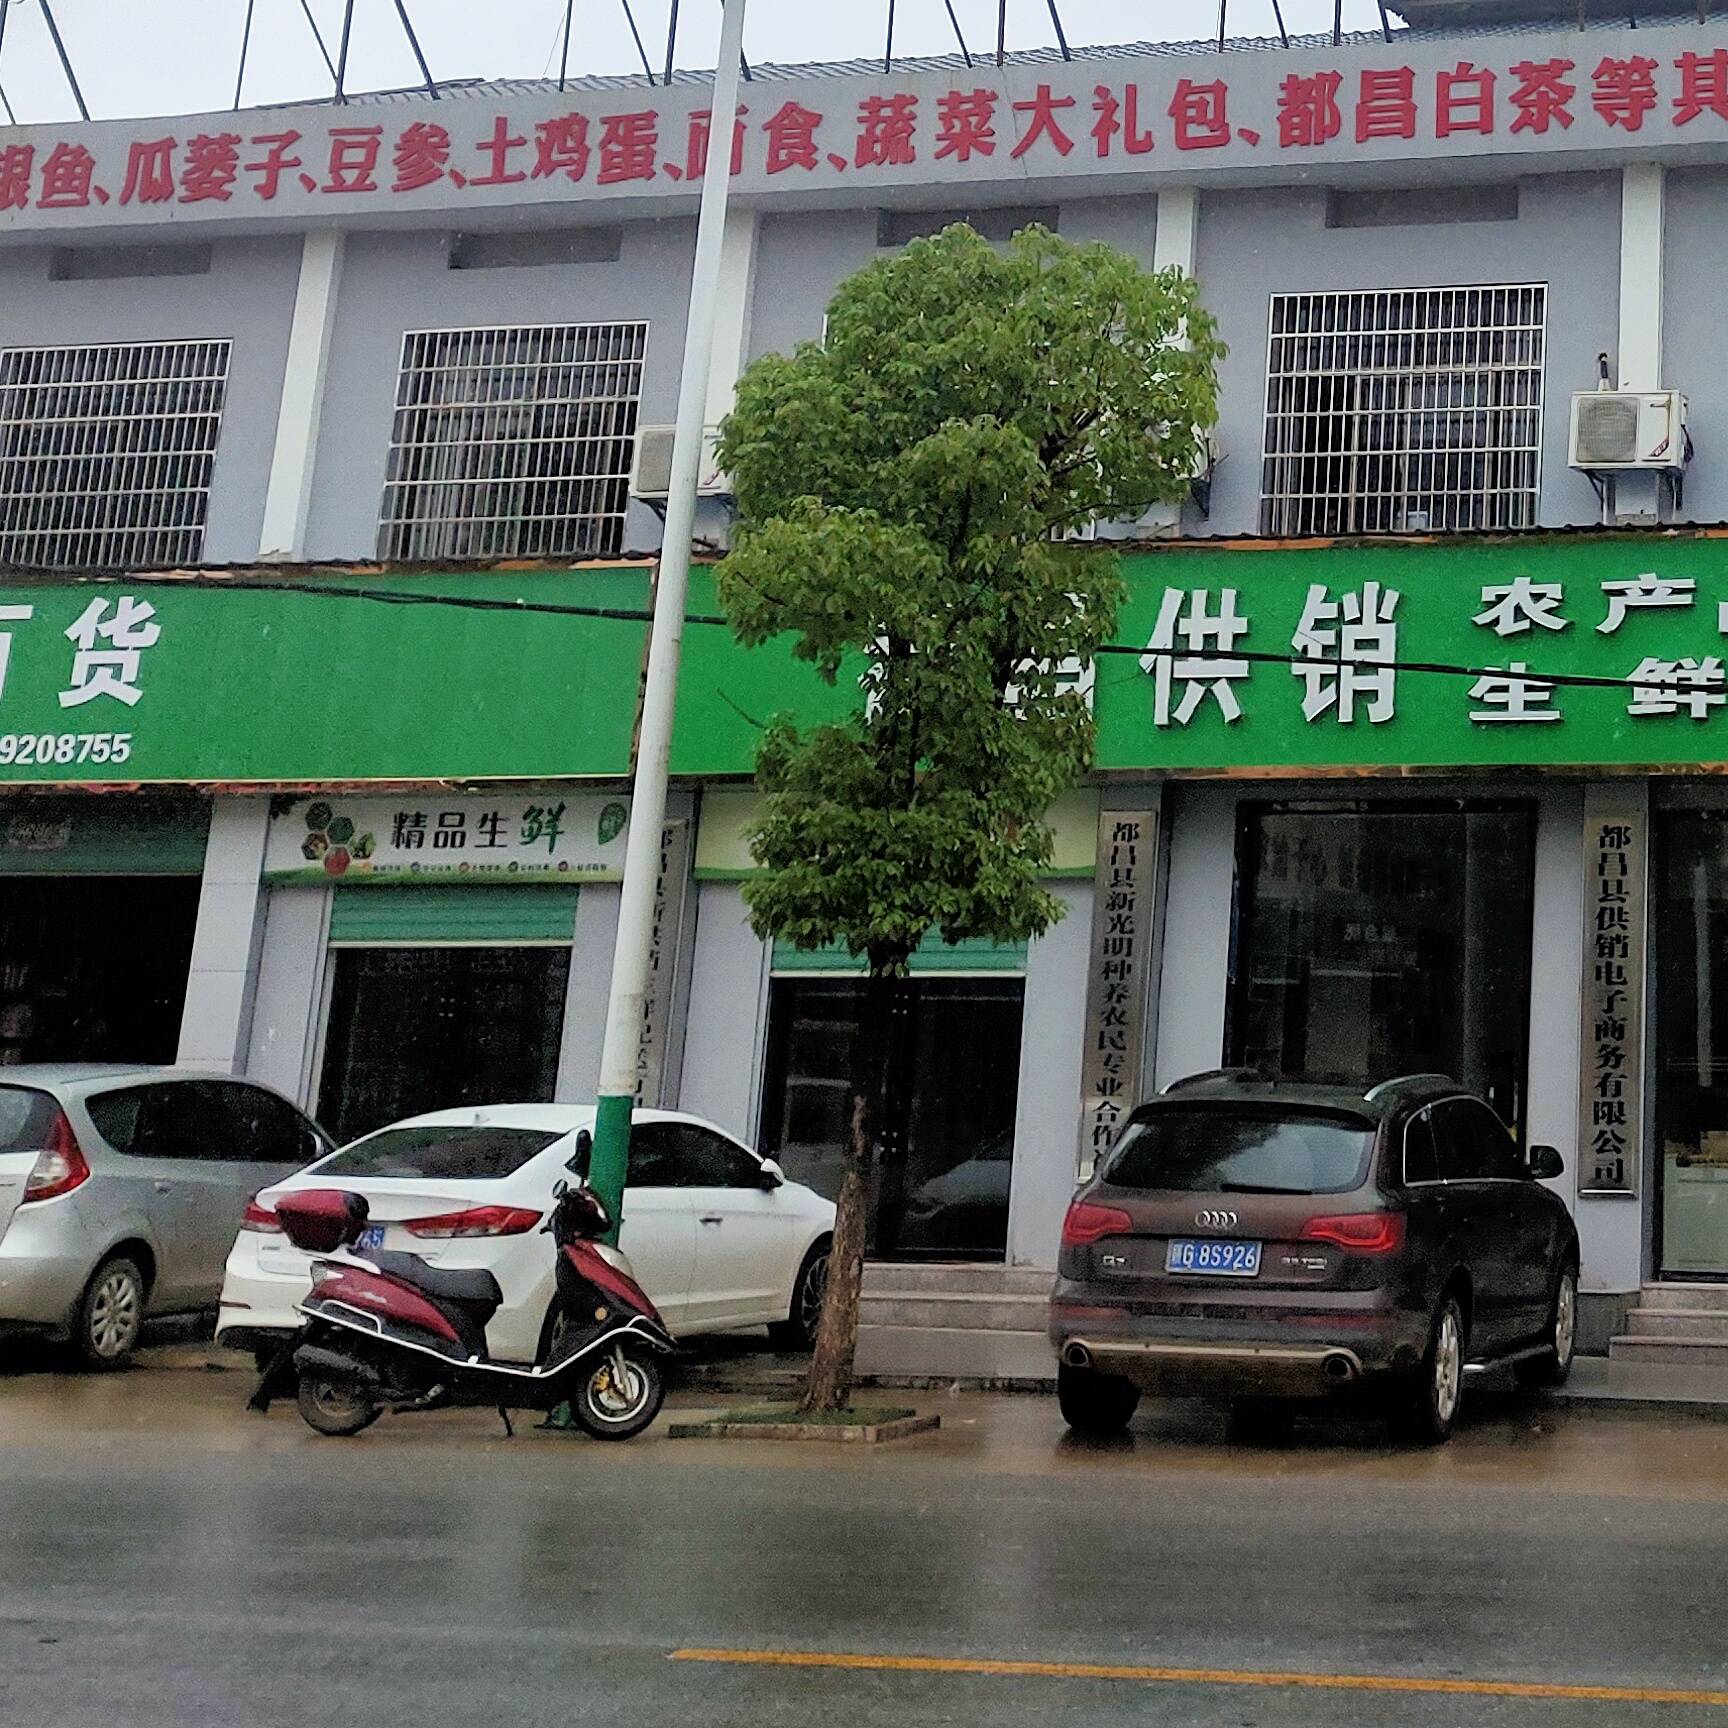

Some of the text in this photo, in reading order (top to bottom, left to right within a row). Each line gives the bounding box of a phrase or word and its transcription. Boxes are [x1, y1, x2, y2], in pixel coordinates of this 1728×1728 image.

[0, 733, 132, 765] 9208755
[391, 801, 567, 855] 精品生鲜
[1591, 824, 1632, 1184] 都昌县供销电子商务有限公司
